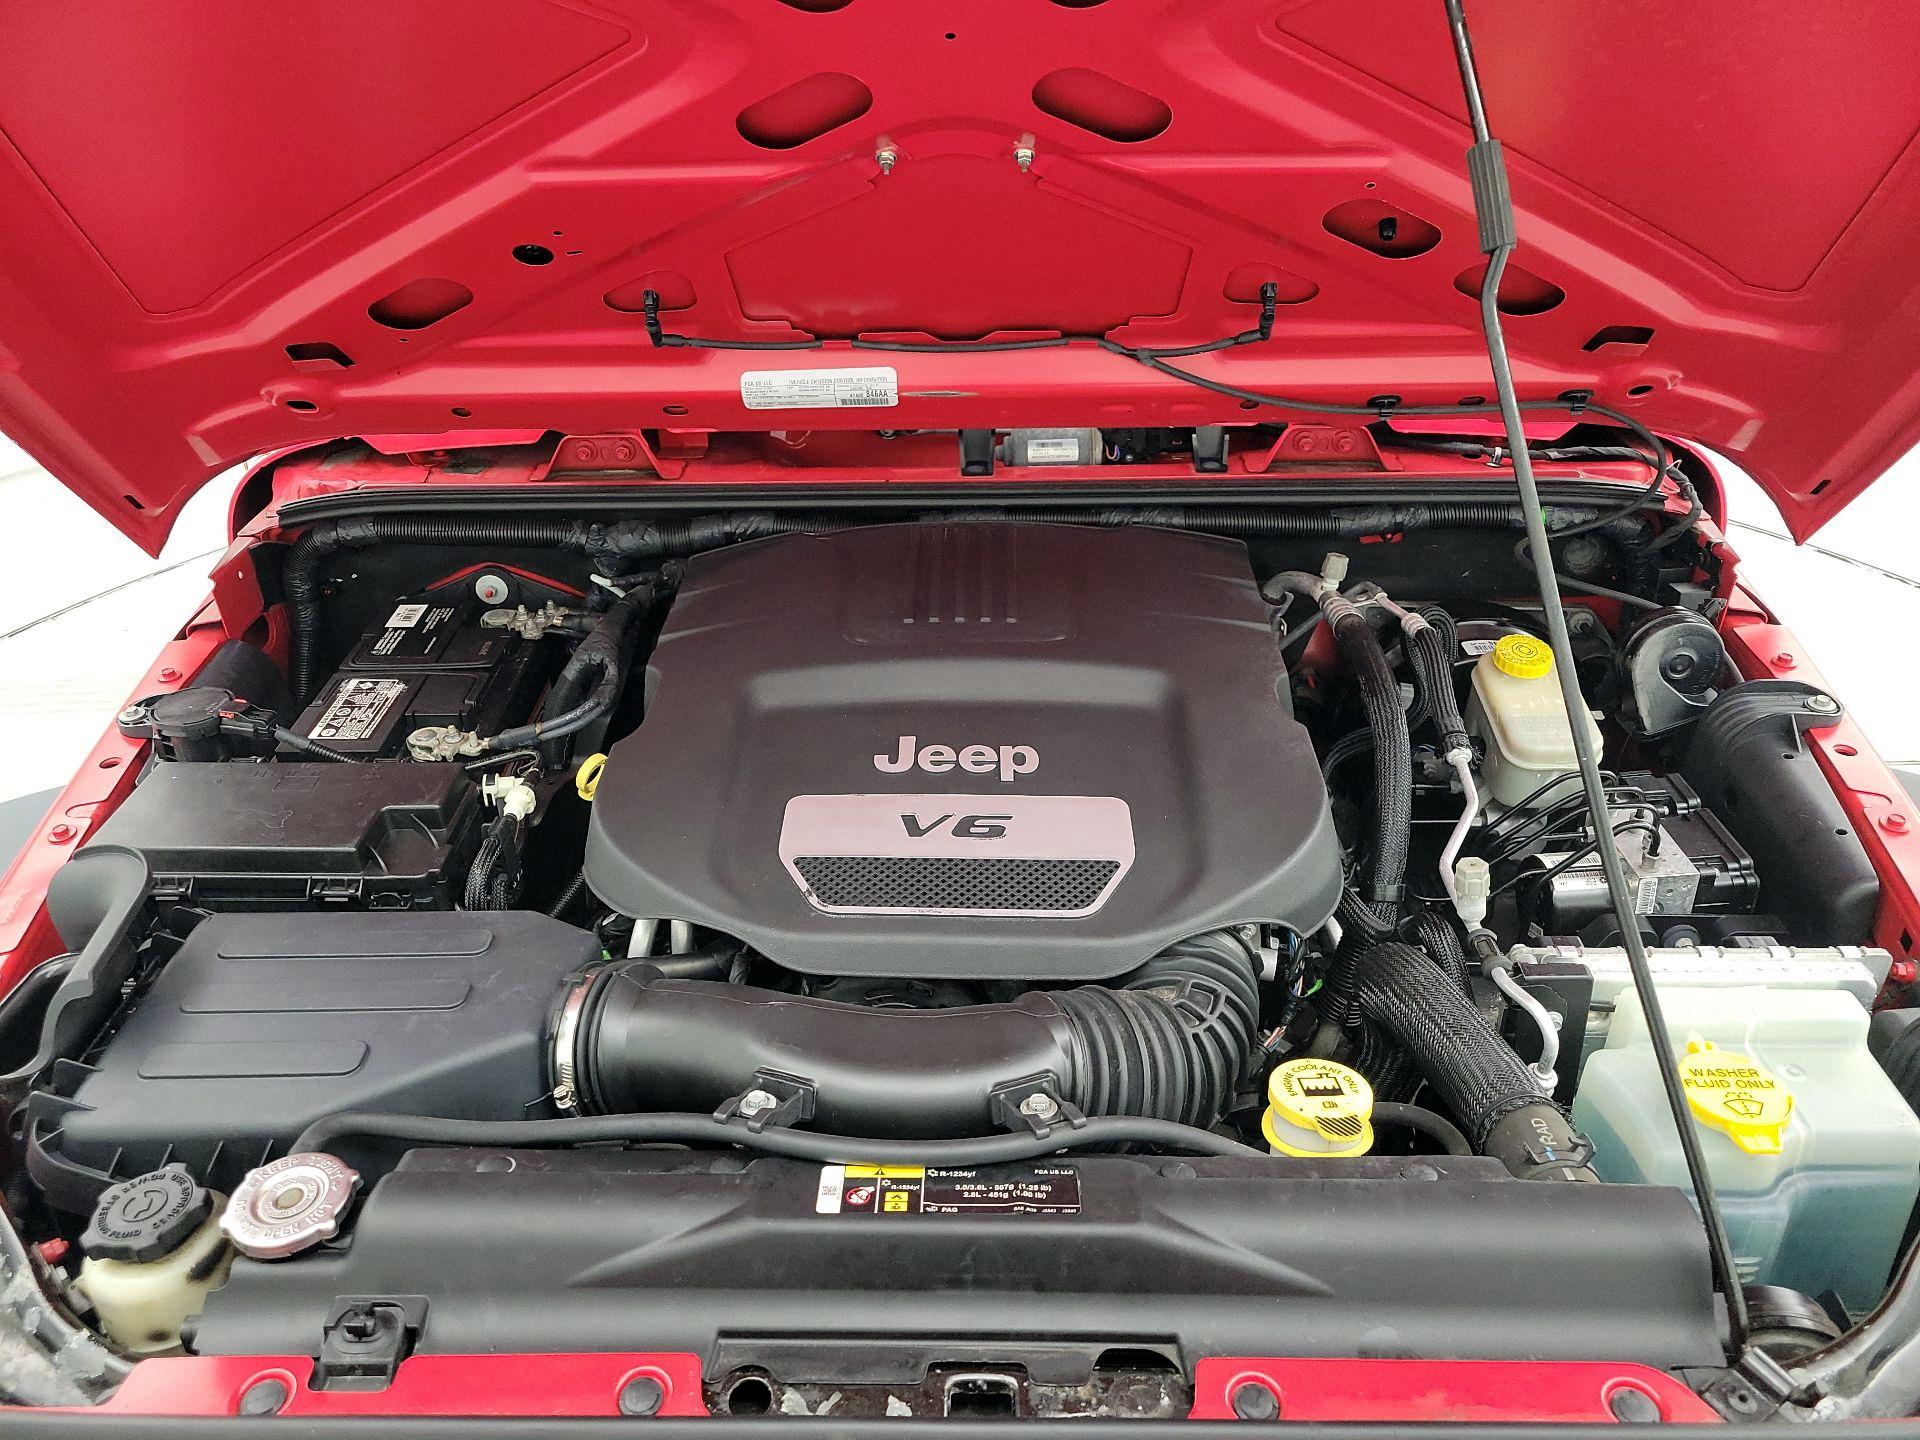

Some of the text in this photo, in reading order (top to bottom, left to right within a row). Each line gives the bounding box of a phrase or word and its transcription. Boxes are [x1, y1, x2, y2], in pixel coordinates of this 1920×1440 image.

[873, 735, 1040, 783] Jeep
[900, 813, 1013, 840] V6
[1283, 1063, 1359, 1097] ENGINE COOLANT ONLY
[1684, 1079, 1775, 1089] FLUID ONLY
[1688, 1068, 1760, 1078] WASHER
[1530, 1117, 1557, 1146] RAD
[258, 1156, 299, 1180] KEEP
[939, 1170, 976, 1178] R-1234yf
[1040, 1184, 1052, 1192] lb)
